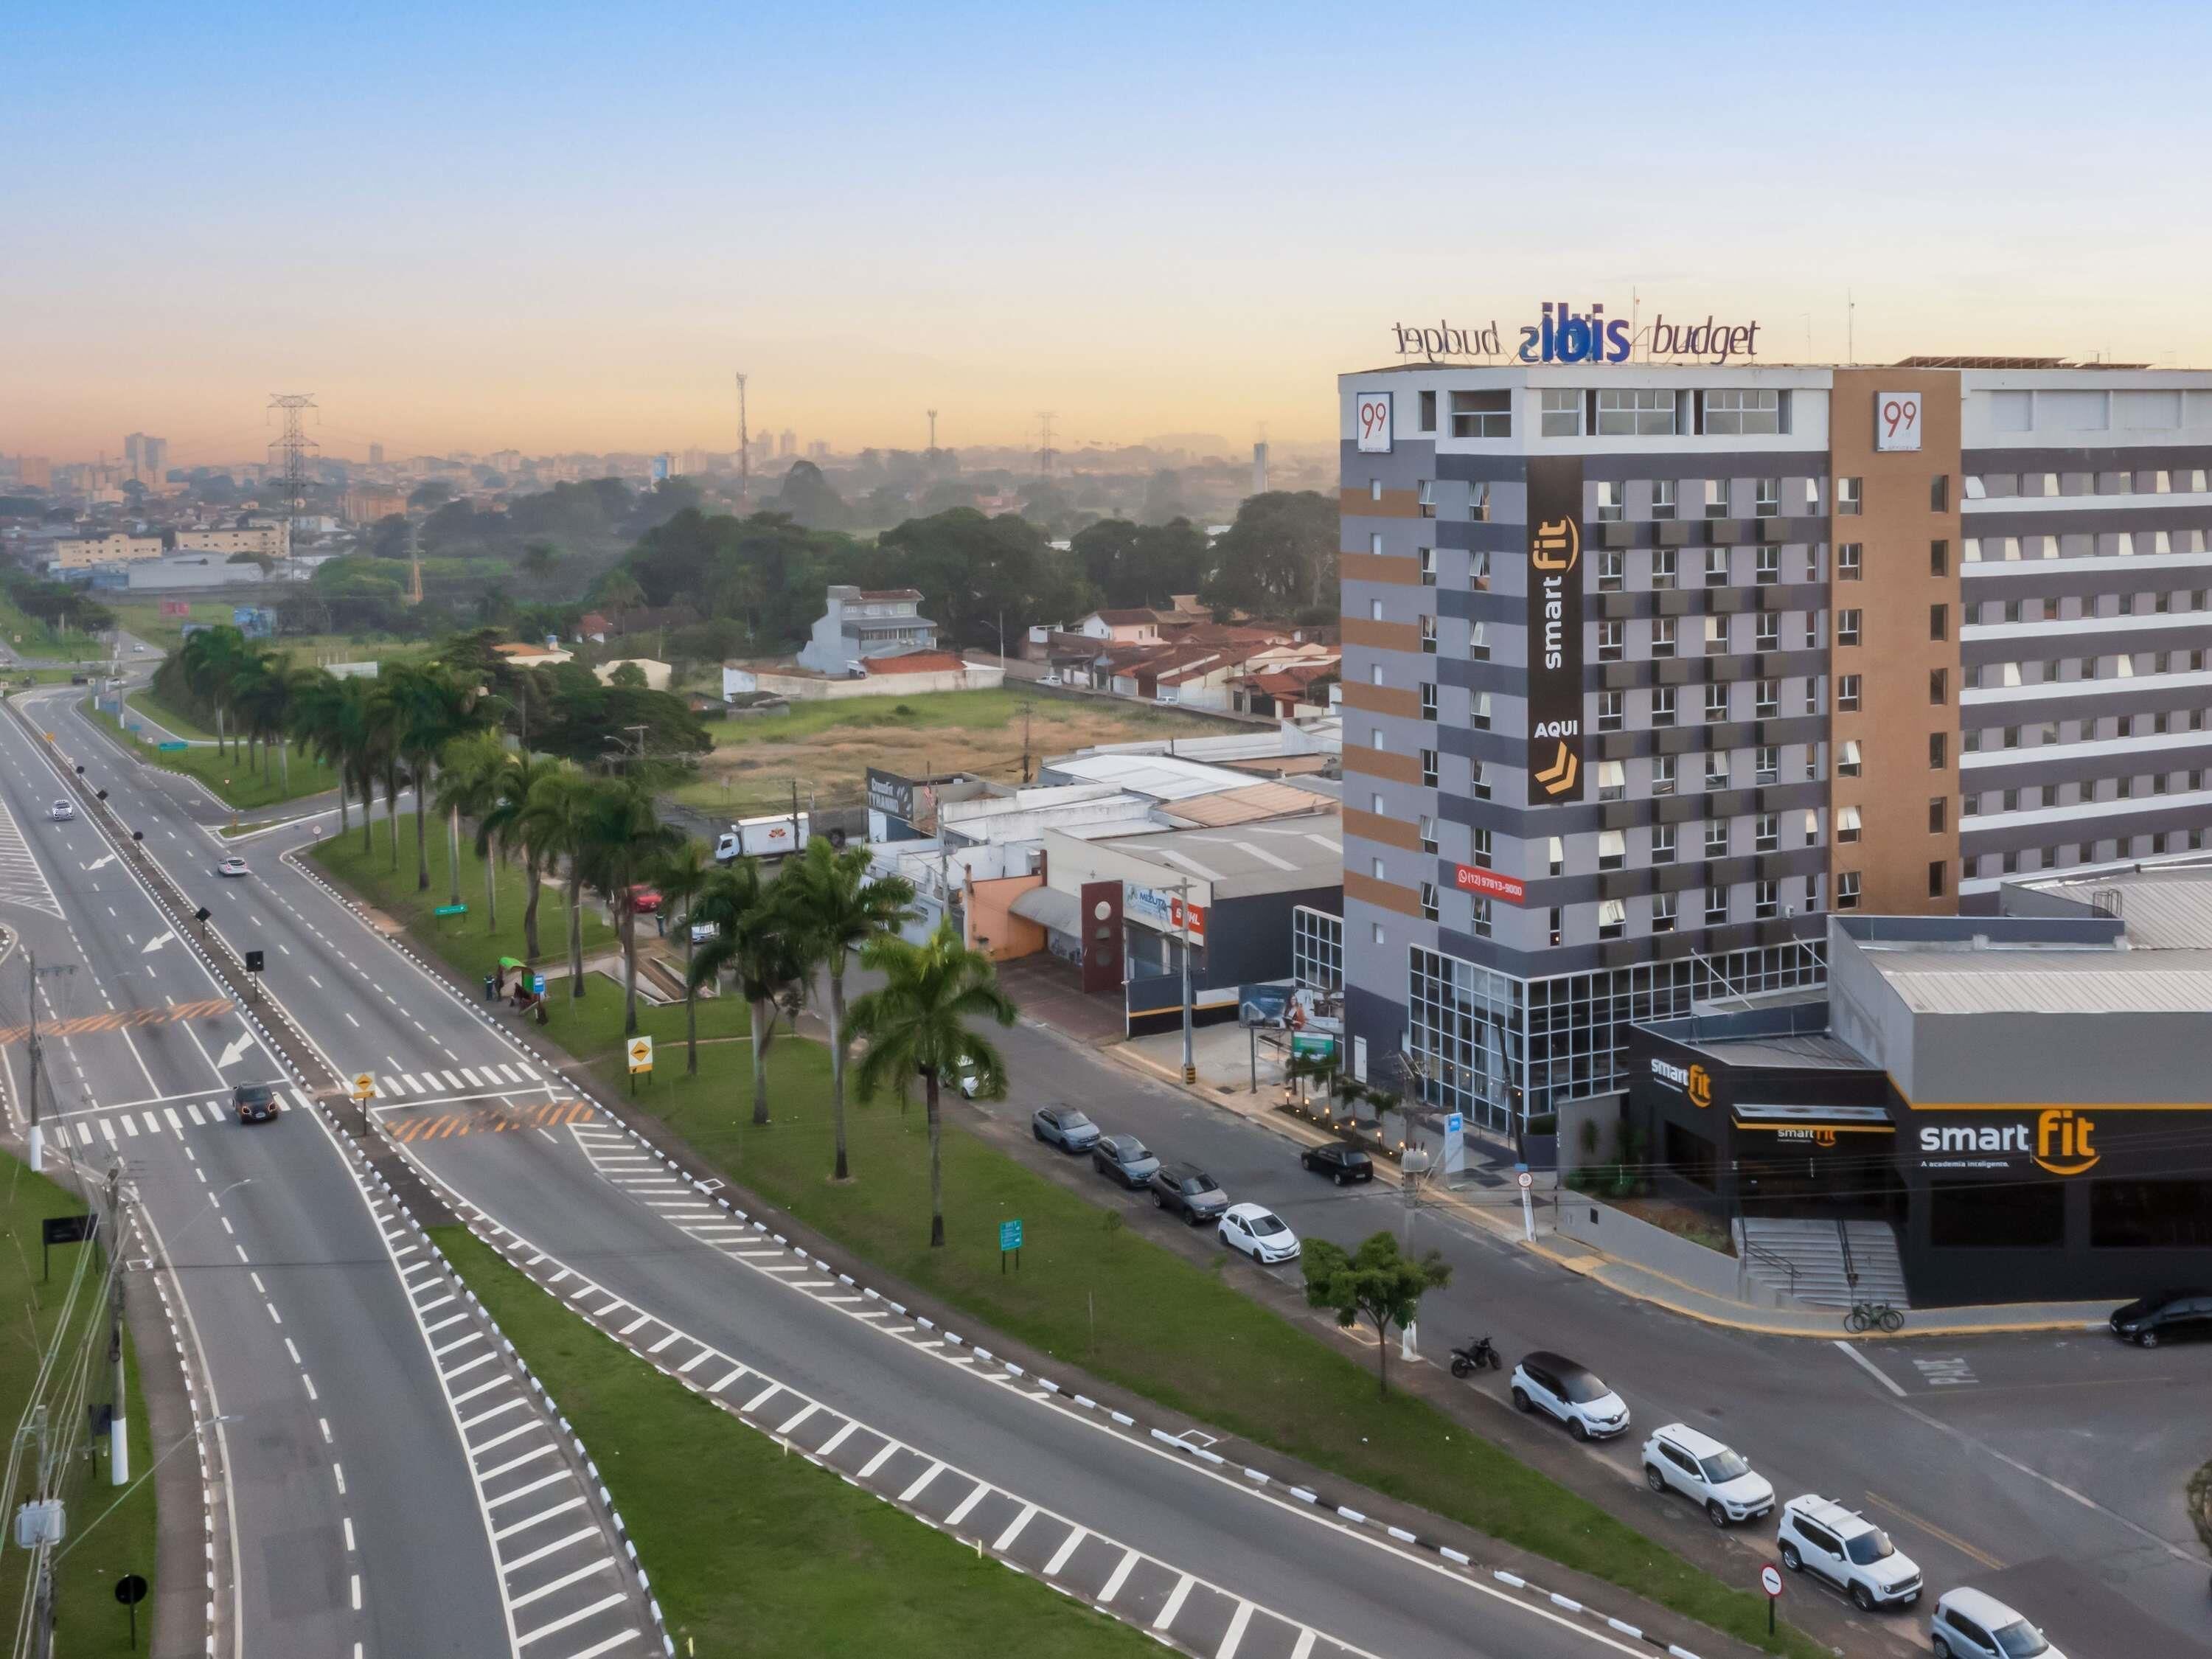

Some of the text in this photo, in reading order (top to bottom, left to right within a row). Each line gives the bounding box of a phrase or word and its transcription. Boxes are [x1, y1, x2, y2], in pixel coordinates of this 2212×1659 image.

[1542, 302, 1630, 362] ibis
[1652, 314, 1761, 365] budget
[1361, 403, 1386, 439] 99
[1884, 400, 1916, 438] 99
[1532, 519, 1567, 669] smart fit
[1534, 720, 1578, 738] AQUI
[1651, 1058, 1689, 1086] smart
[1689, 1064, 1711, 1099] fit
[1919, 1109, 2096, 1157] smart fit
[1929, 1160, 1966, 1168] academia
